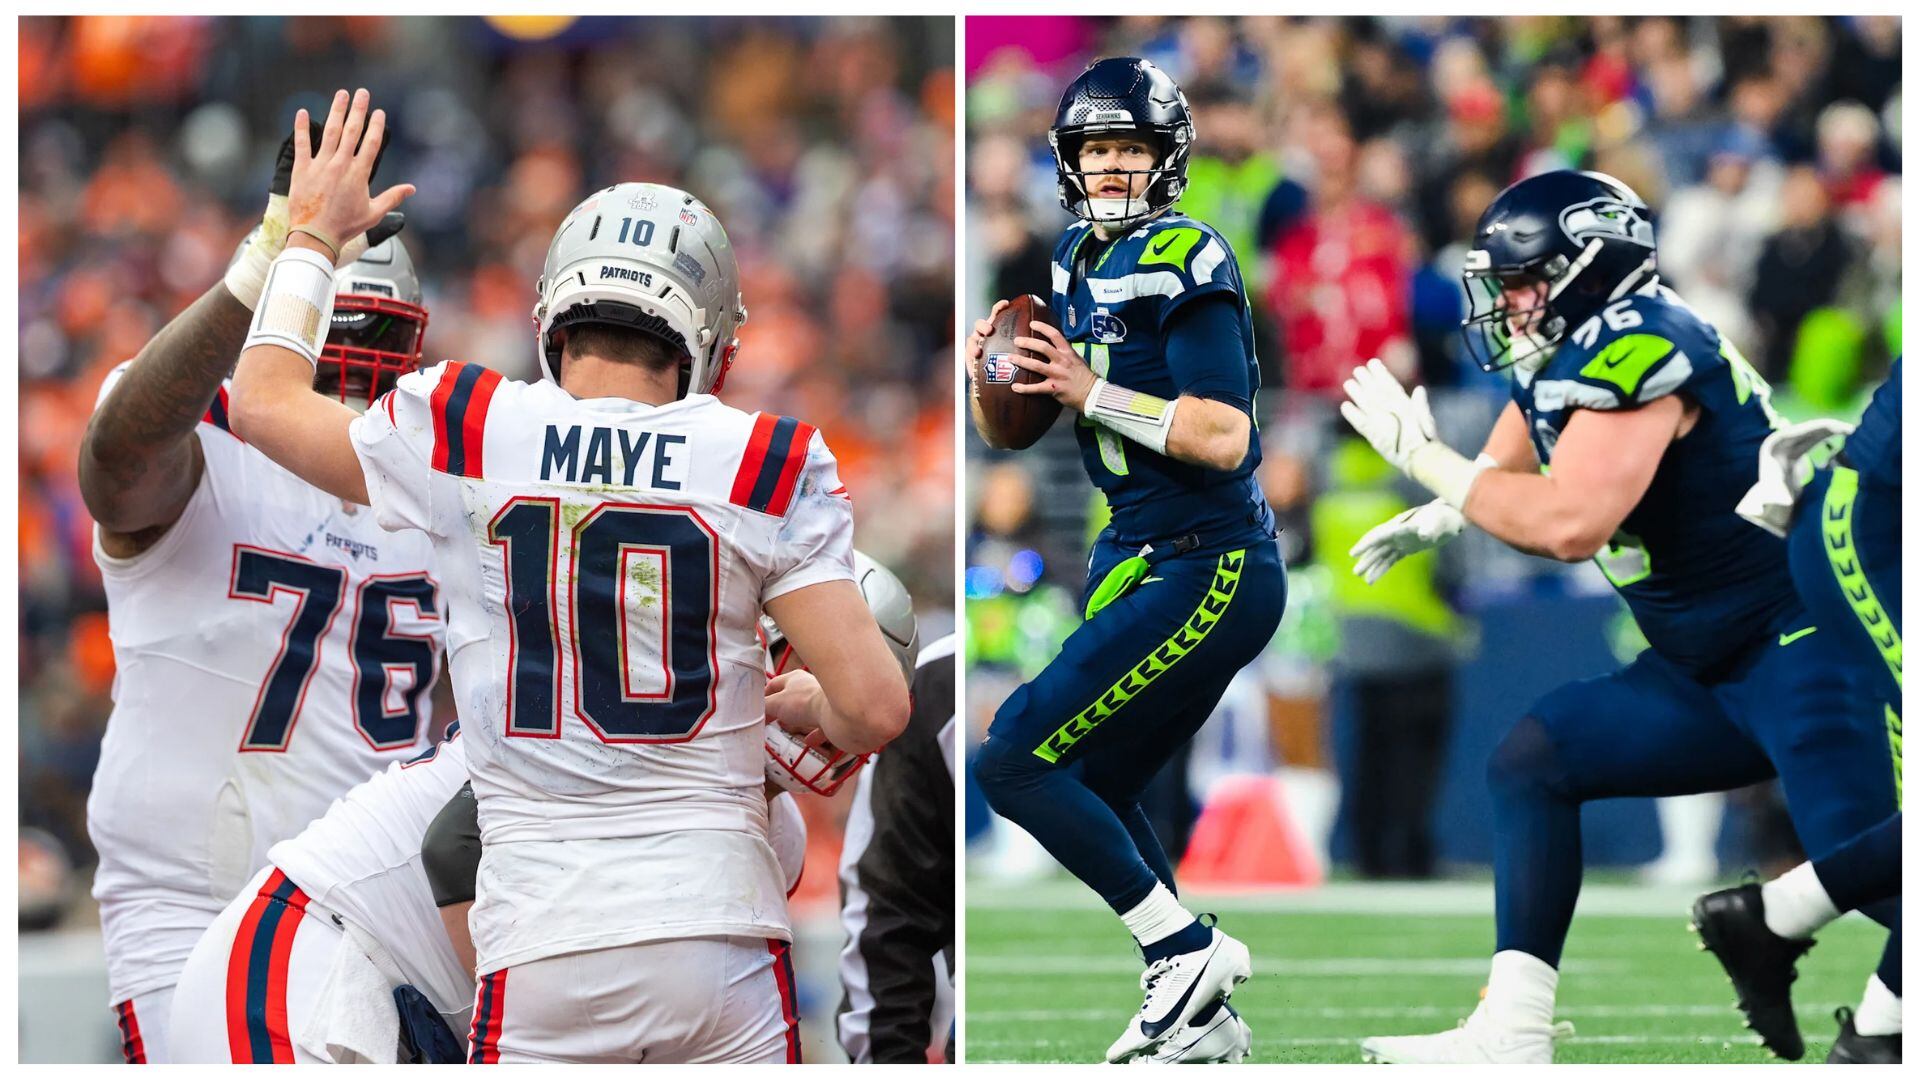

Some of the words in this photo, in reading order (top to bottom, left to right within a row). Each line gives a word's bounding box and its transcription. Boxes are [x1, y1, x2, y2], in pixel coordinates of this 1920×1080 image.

[617, 217, 655, 247] 10
[600, 265, 652, 287] PATRIOTS
[1571, 299, 1644, 350] 76
[540, 424, 687, 491] MAYE
[326, 532, 378, 561] PATRIOTS
[487, 495, 719, 744] 10
[228, 543, 440, 753] 76
